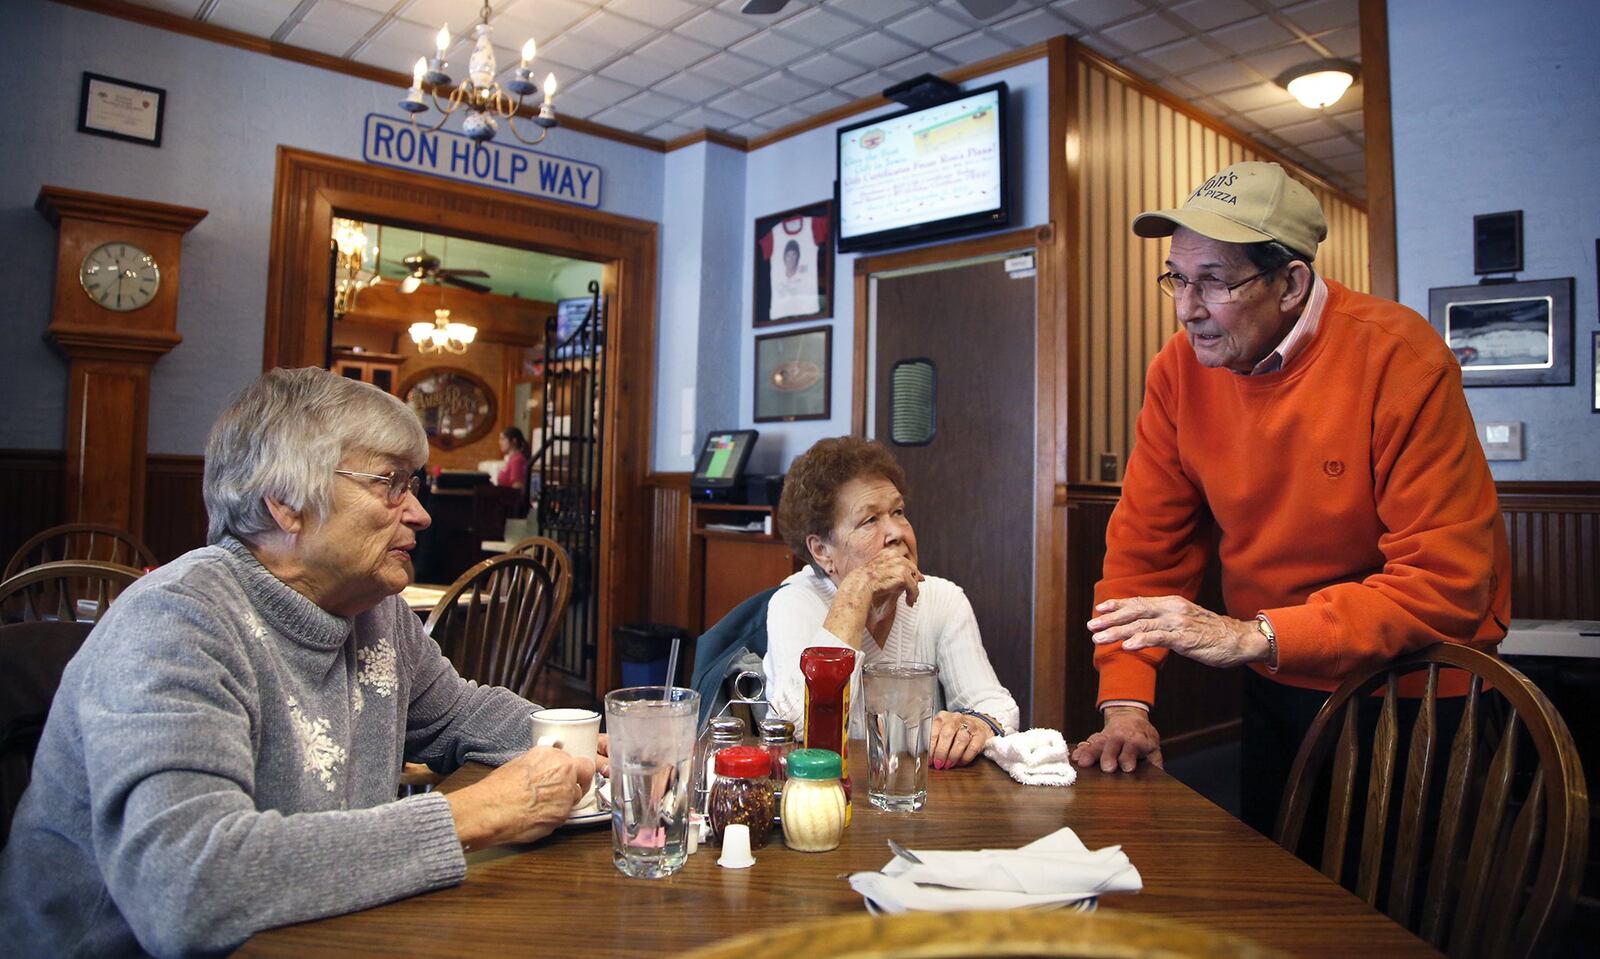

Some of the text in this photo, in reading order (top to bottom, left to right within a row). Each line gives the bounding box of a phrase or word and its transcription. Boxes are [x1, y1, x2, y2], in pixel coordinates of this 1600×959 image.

[374, 122, 593, 199] RON HOLP WAY
[1204, 189, 1237, 205] PIZZA
